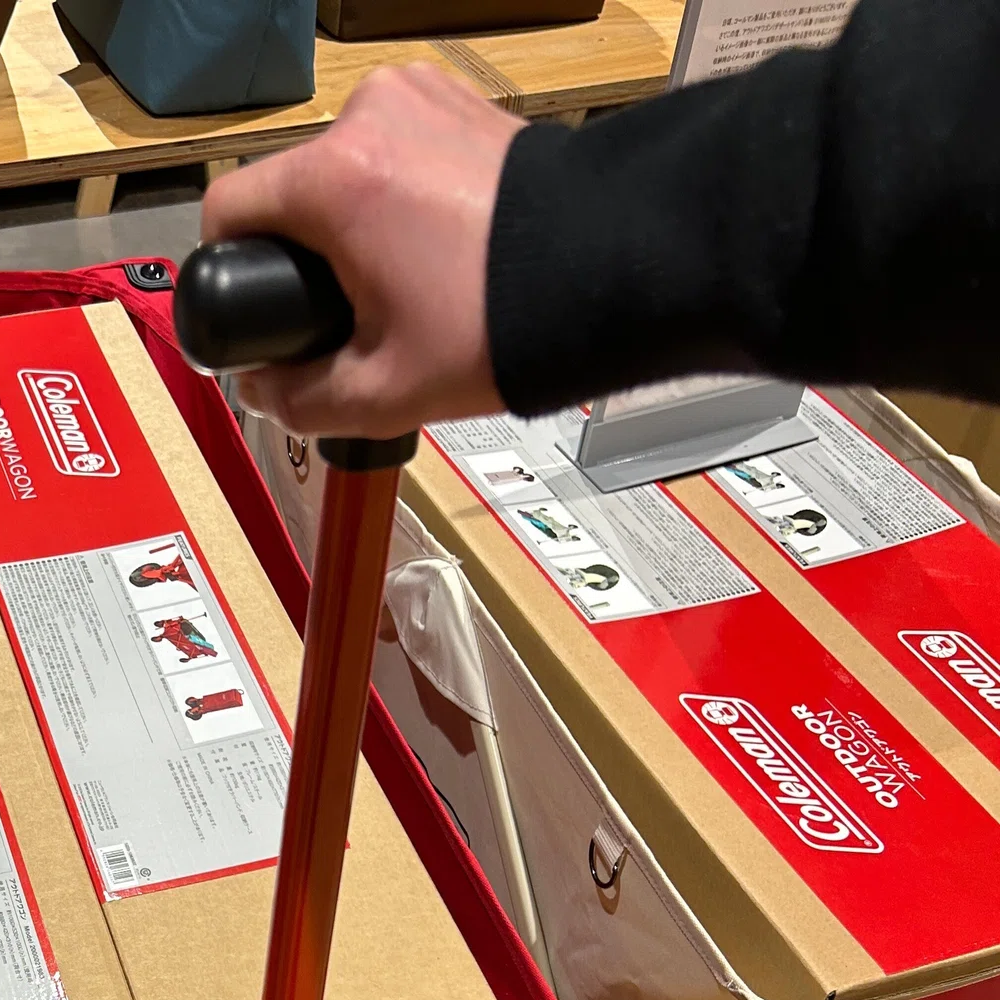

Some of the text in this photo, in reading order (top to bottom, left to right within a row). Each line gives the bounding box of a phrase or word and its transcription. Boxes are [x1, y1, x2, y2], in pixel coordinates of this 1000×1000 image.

[37, 374, 91, 452] Coleman
[728, 727, 850, 841] Coleman
[791, 704, 898, 808] OUTDOOR
[817, 710, 905, 794] WAGON
[848, 711, 921, 782] アウトドアワゴン
[22, 925, 35, 944] Model
